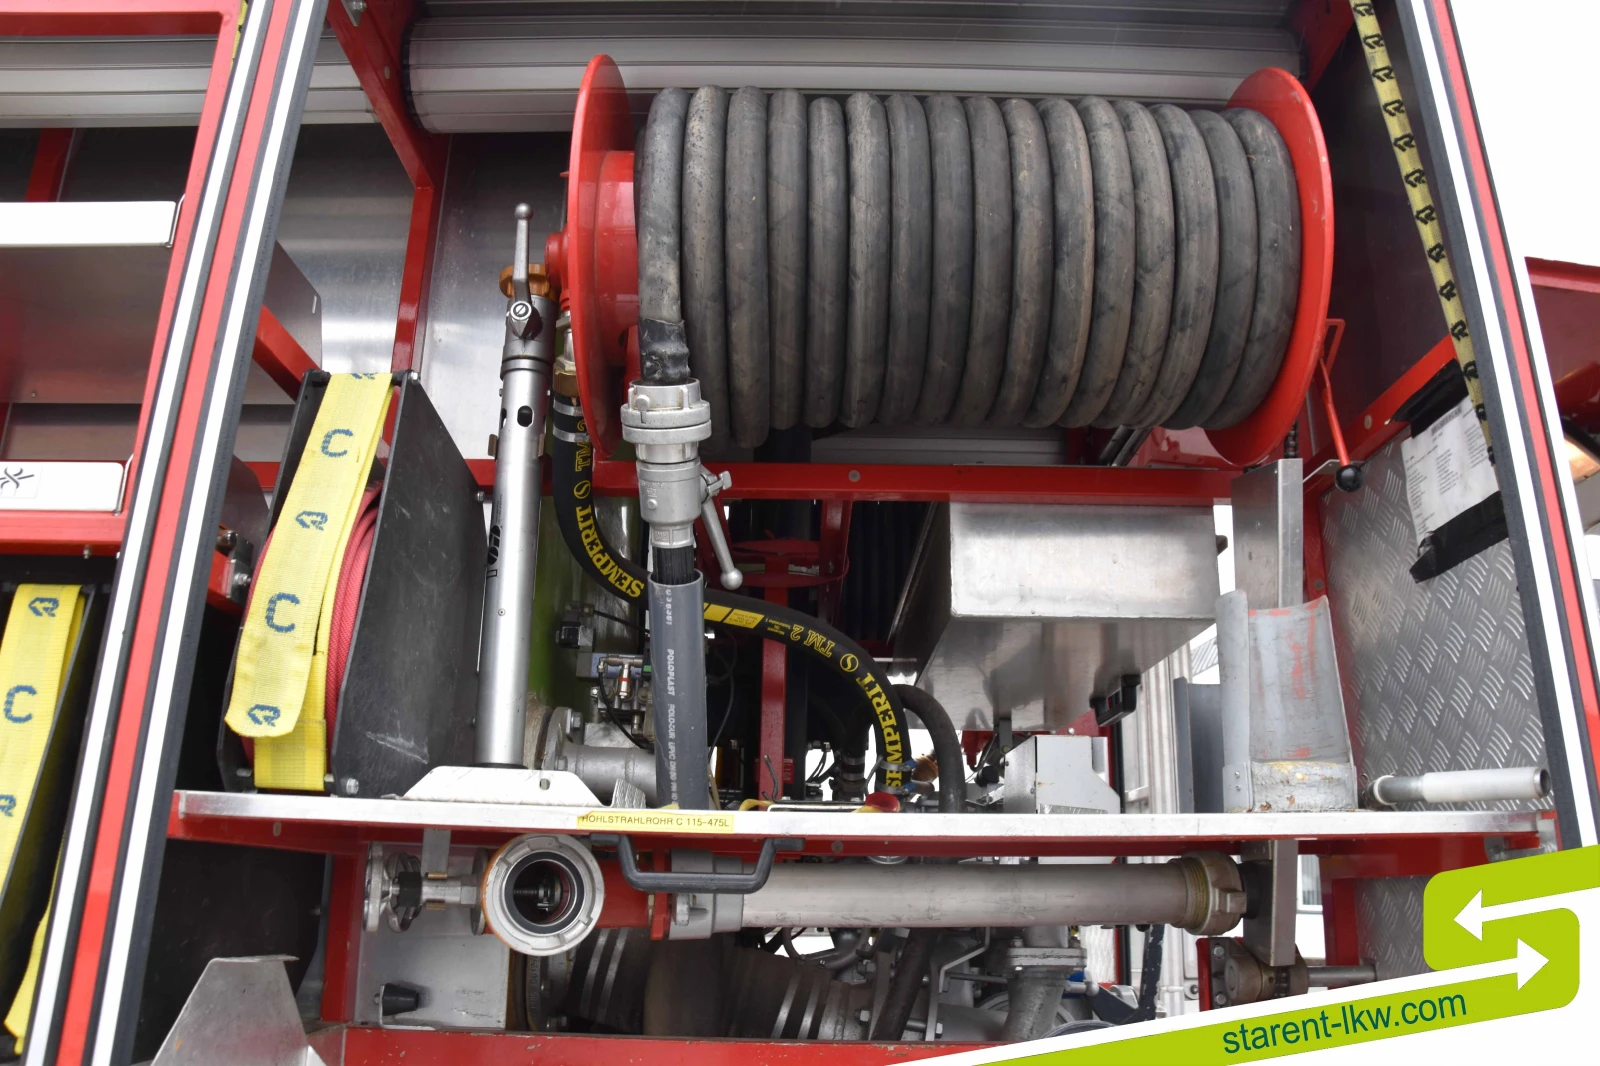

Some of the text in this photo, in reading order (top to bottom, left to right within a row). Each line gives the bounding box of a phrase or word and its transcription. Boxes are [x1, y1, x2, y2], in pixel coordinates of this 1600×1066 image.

[321, 428, 354, 458] C
[575, 505, 645, 598] SEMPERIT
[265, 592, 300, 633] C
[790, 624, 805, 641] 2
[804, 629, 835, 658] TM
[667, 648, 676, 696] POLOPLAST
[3, 684, 37, 724] C
[582, 814, 730, 827] HOHLSTRAHLROHR C 115-475L
